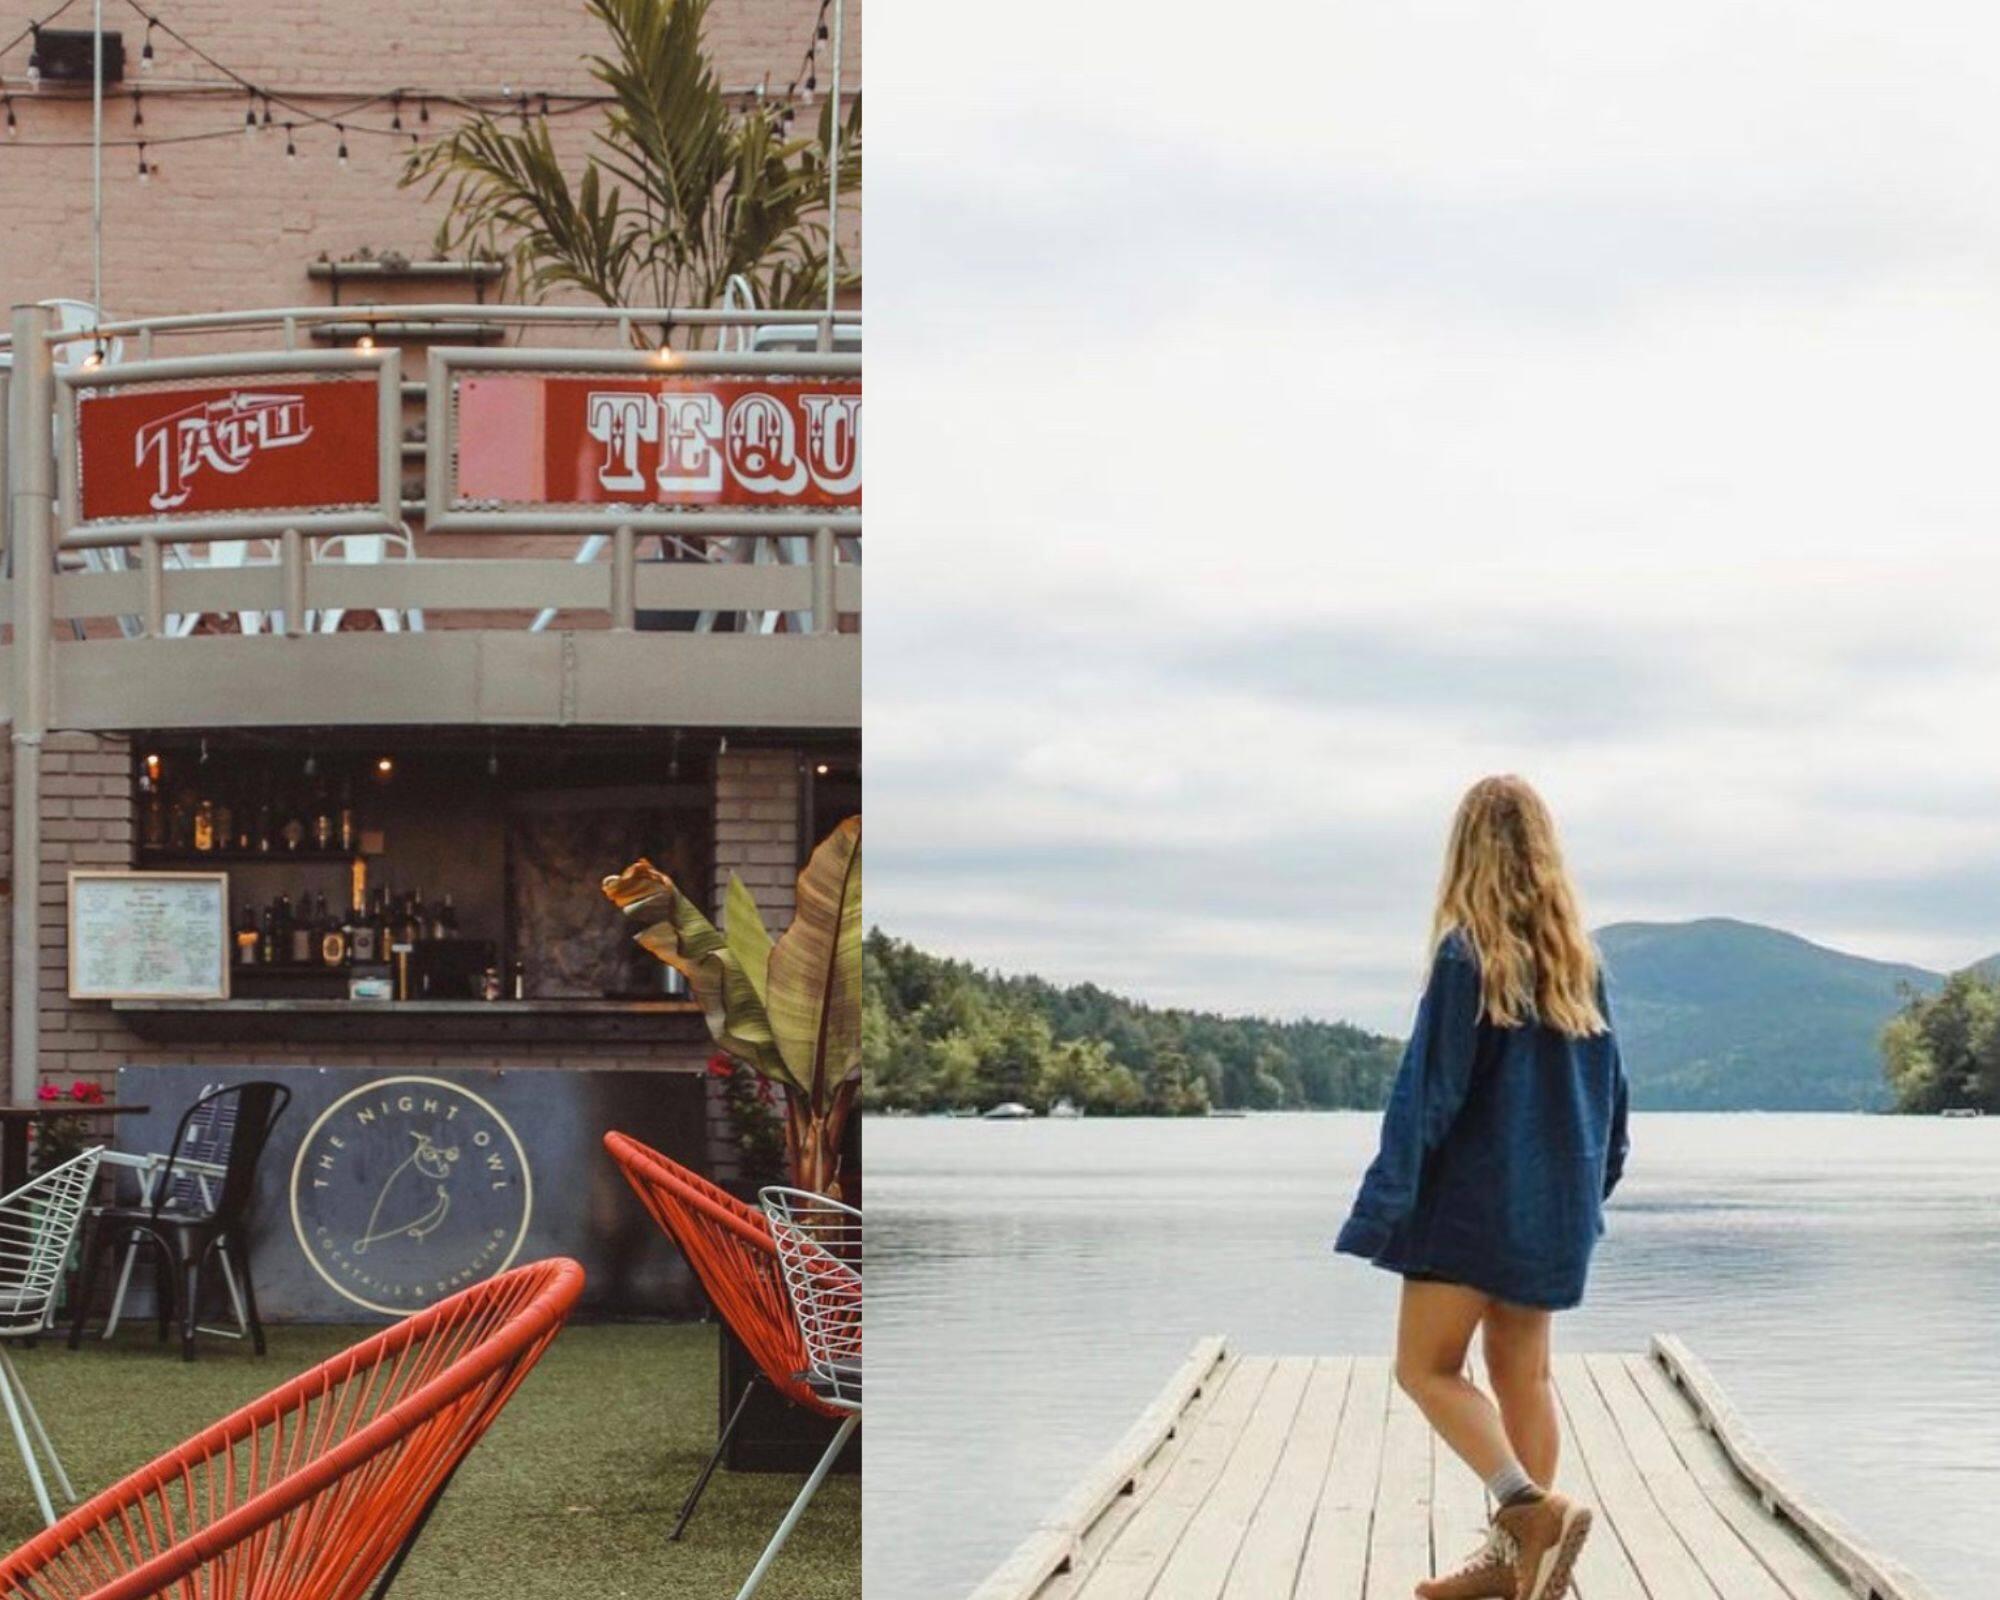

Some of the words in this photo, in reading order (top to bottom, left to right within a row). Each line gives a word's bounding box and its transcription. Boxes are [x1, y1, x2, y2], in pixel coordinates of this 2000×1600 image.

[587, 391, 862, 496] TEQU
[313, 1135, 346, 1189] THE
[356, 1096, 459, 1126] NIGHT
[472, 1130, 507, 1190] OWL
[316, 1226, 403, 1296] COCKTAILS
[436, 1228, 506, 1292] DANCING
